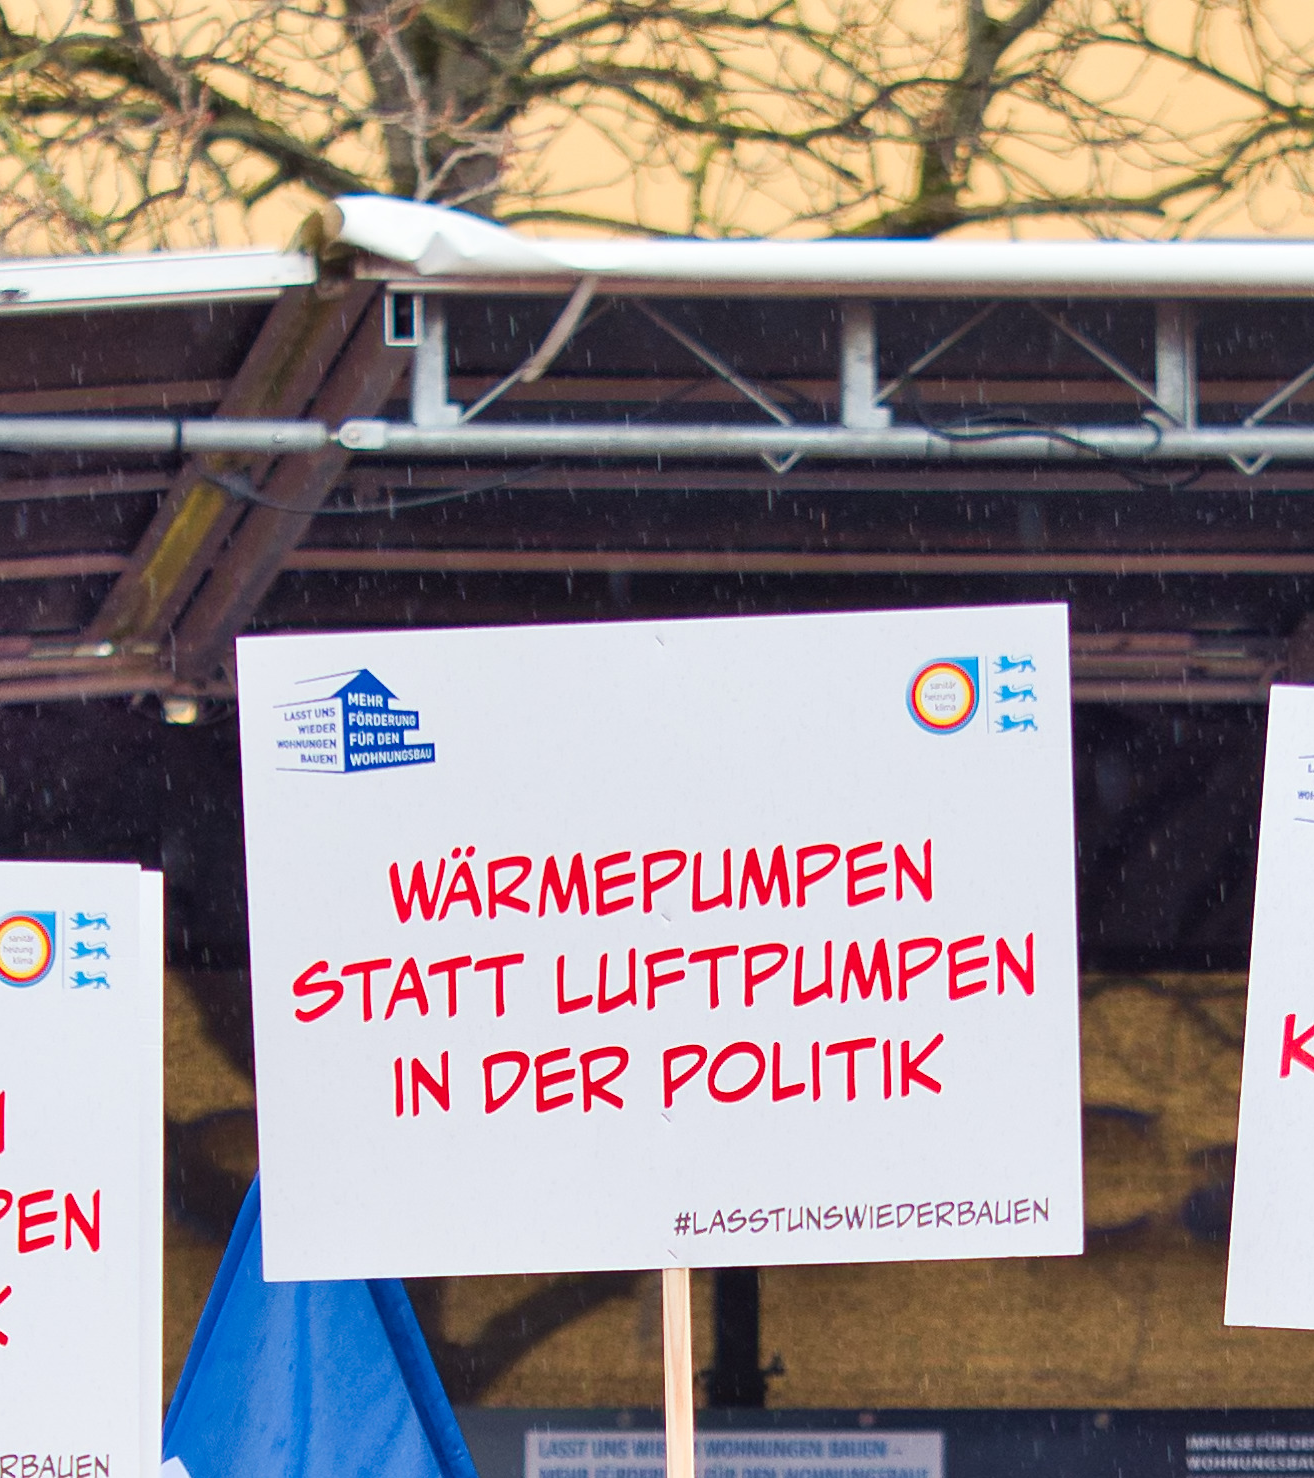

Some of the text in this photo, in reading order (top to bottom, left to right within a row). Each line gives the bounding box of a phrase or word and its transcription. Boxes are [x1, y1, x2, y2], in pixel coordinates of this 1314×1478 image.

[347, 692, 384, 708] MEHR
[284, 707, 336, 721] LASST UNS
[348, 709, 417, 727] FÖRDERUNG
[297, 723, 336, 735] WIEDER
[349, 730, 400, 746] FÜR DEN
[349, 748, 432, 767] WOHNUNGSBAU
[388, 838, 934, 924] WÄRMEPUMPEN
[292, 932, 1035, 1023] STATT LUFTPUMPEN
[393, 1032, 945, 1118] IN DER POLITIK
[673, 1197, 1051, 1237] #LASSTUNSWIEDERBAUEN
